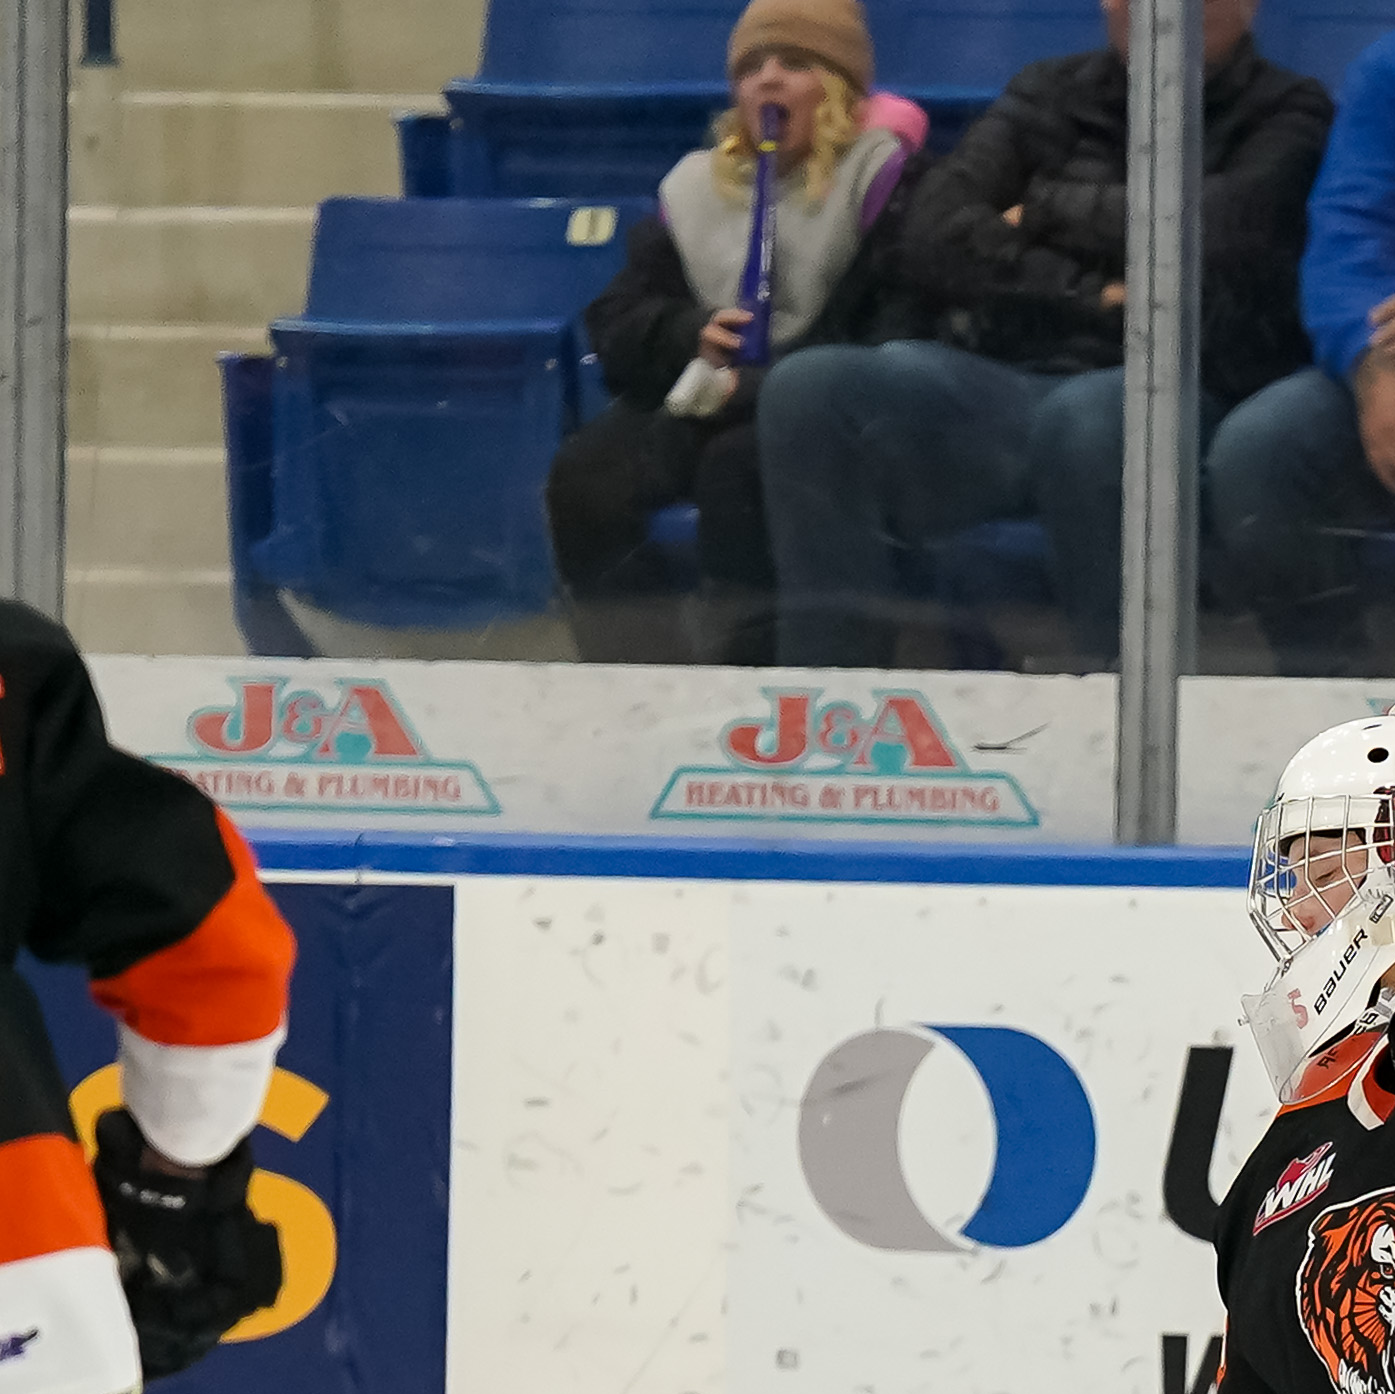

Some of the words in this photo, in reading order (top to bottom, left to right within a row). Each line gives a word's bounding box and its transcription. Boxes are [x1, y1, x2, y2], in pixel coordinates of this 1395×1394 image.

[190, 677, 428, 760] J&A
[722, 688, 968, 774] J&A
[190, 770, 275, 797] ATING
[317, 773, 462, 802] PLUMBING
[685, 781, 808, 808] HEATING
[852, 784, 1001, 814] PLUMBING
[1261, 1152, 1337, 1219] WHL
